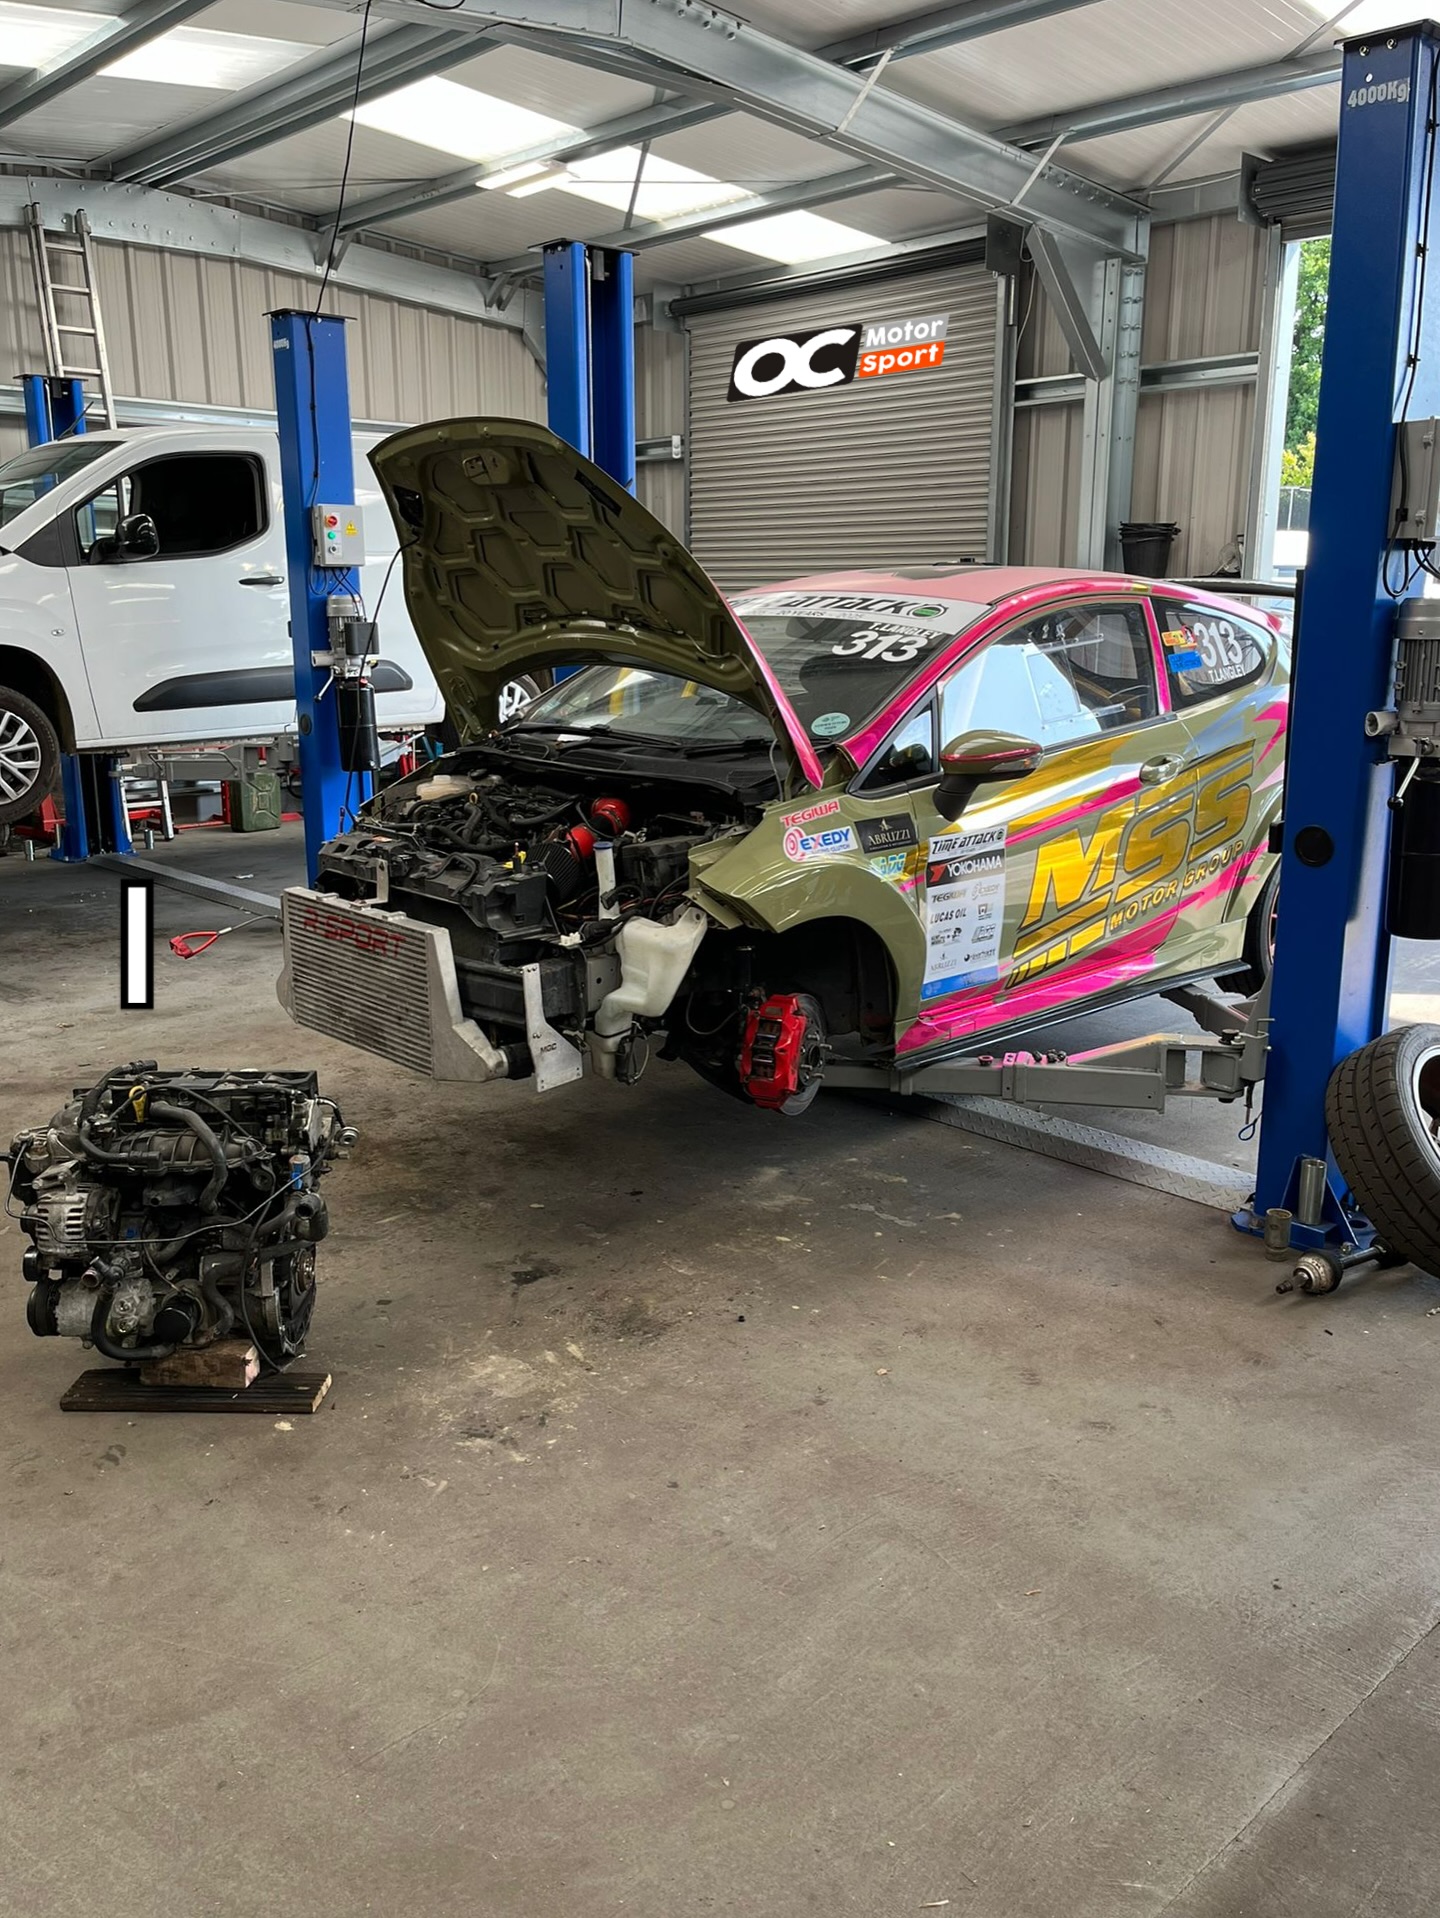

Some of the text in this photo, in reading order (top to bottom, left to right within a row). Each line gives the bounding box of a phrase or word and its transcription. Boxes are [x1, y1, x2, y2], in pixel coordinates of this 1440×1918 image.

[1347, 81, 1408, 108] 4000Kg
[866, 319, 944, 348] Motor
[733, 328, 856, 397] OC
[868, 622, 943, 640] T.LANGLEY
[1193, 620, 1243, 668] 313
[832, 630, 929, 663] 313
[1207, 664, 1246, 683] T.LANGLEY
[782, 801, 840, 827] TEGIWA
[800, 828, 850, 851] EXEDY
[868, 829, 911, 846] ABRUZZI
[1016, 738, 1257, 934] MSS
[947, 855, 1003, 878] YOKOHAMA
[1109, 840, 1245, 931] MOTOR GROUP
[930, 910, 955, 924] LUCAS
[954, 908, 968, 920] OIL
